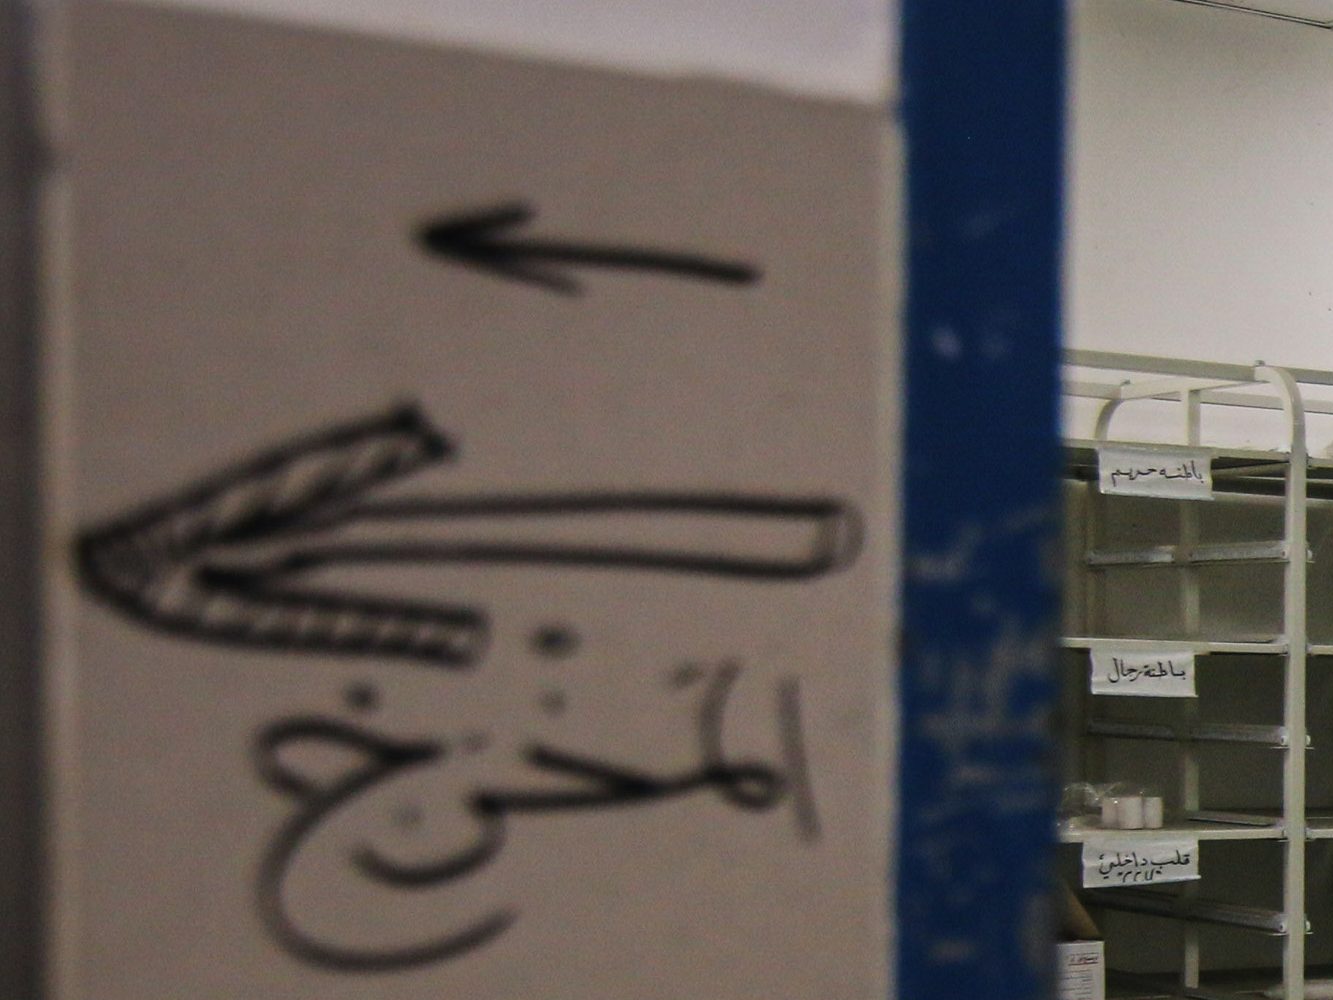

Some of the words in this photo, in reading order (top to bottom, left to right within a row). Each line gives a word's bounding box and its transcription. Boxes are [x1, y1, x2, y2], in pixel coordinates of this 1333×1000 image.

[1111, 466, 1157, 488] حريم
[251, 622, 822, 975] المخرج
[1151, 849, 1190, 869] قلب
